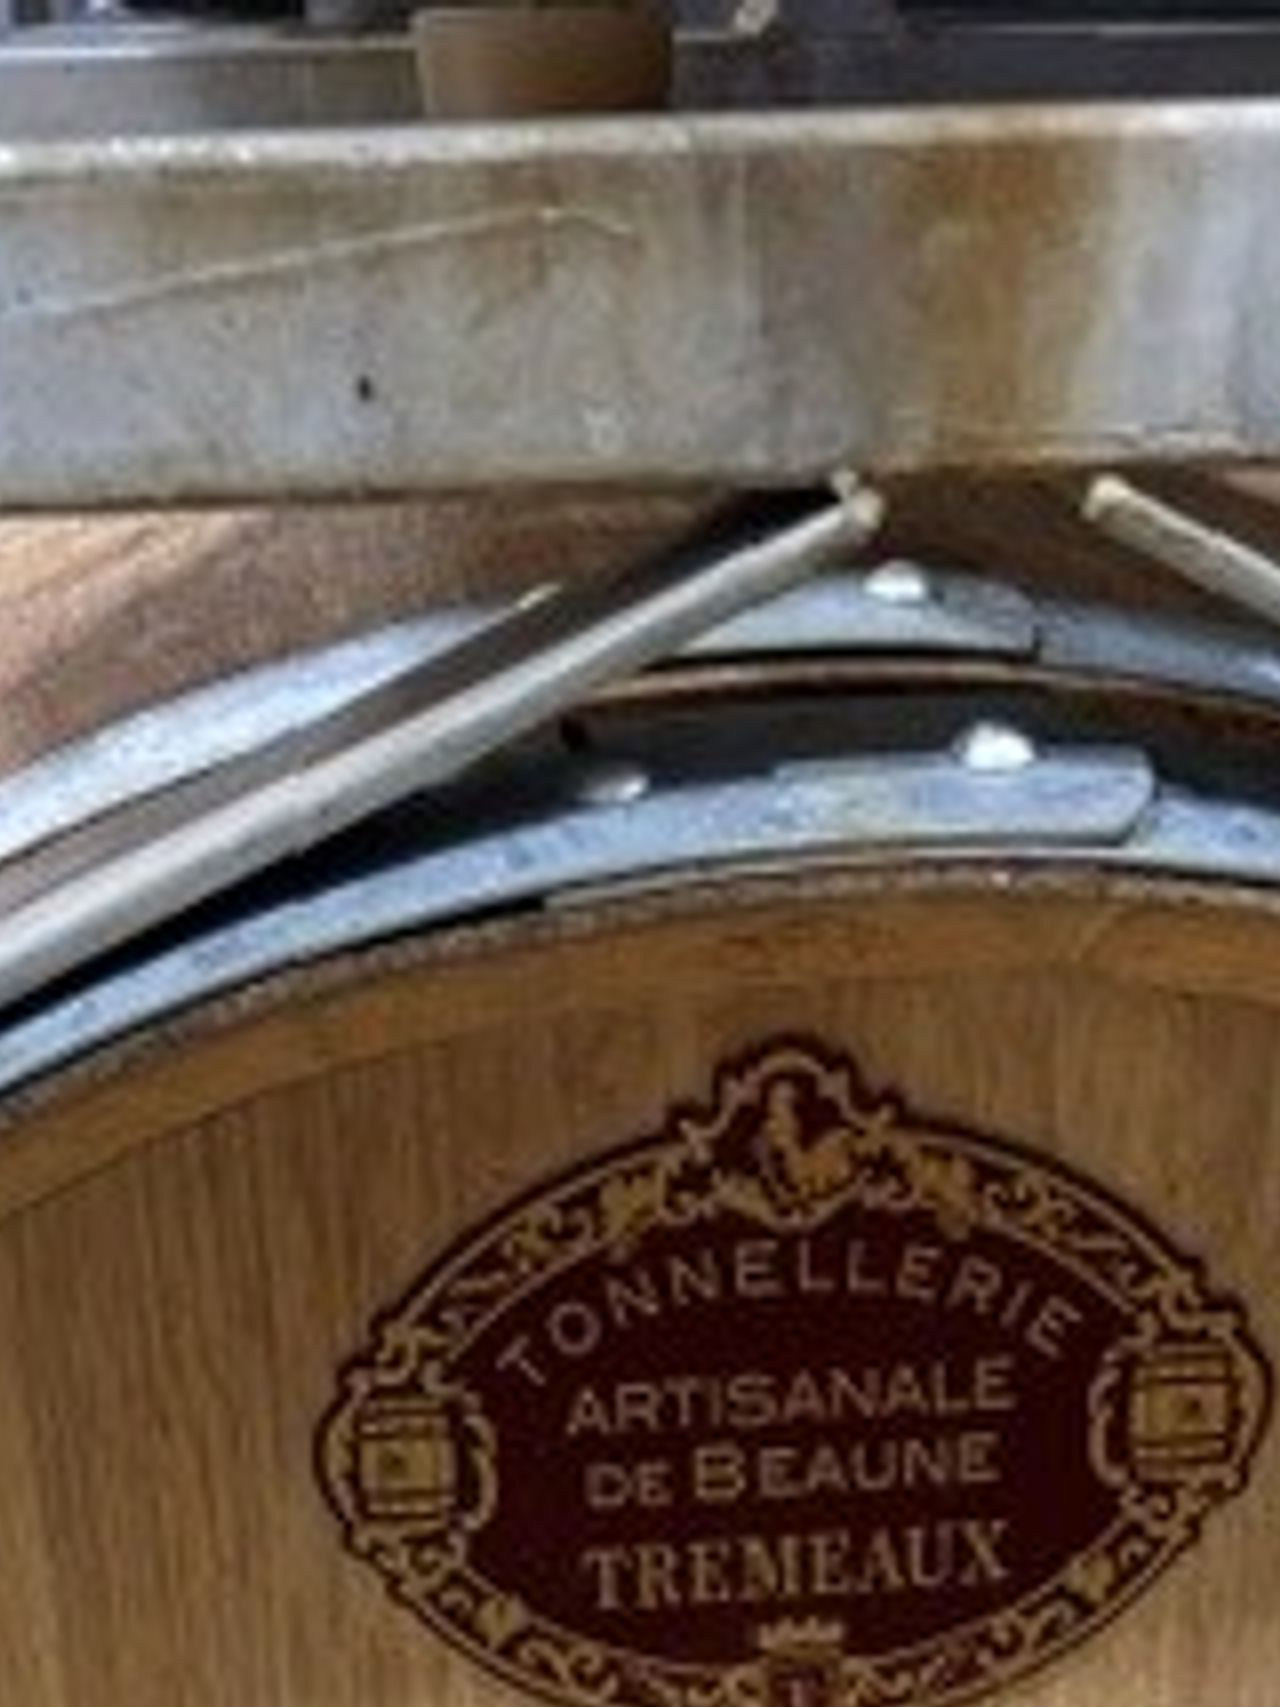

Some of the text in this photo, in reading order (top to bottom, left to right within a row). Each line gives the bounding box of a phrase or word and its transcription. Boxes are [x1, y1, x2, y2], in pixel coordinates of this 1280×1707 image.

[496, 1238, 1087, 1390] TONNELLERIE
[566, 1355, 1018, 1437] ARTISANALE
[585, 1431, 1002, 1510] DE BEAUNE
[582, 1518, 1010, 1612] TREMEAUX
